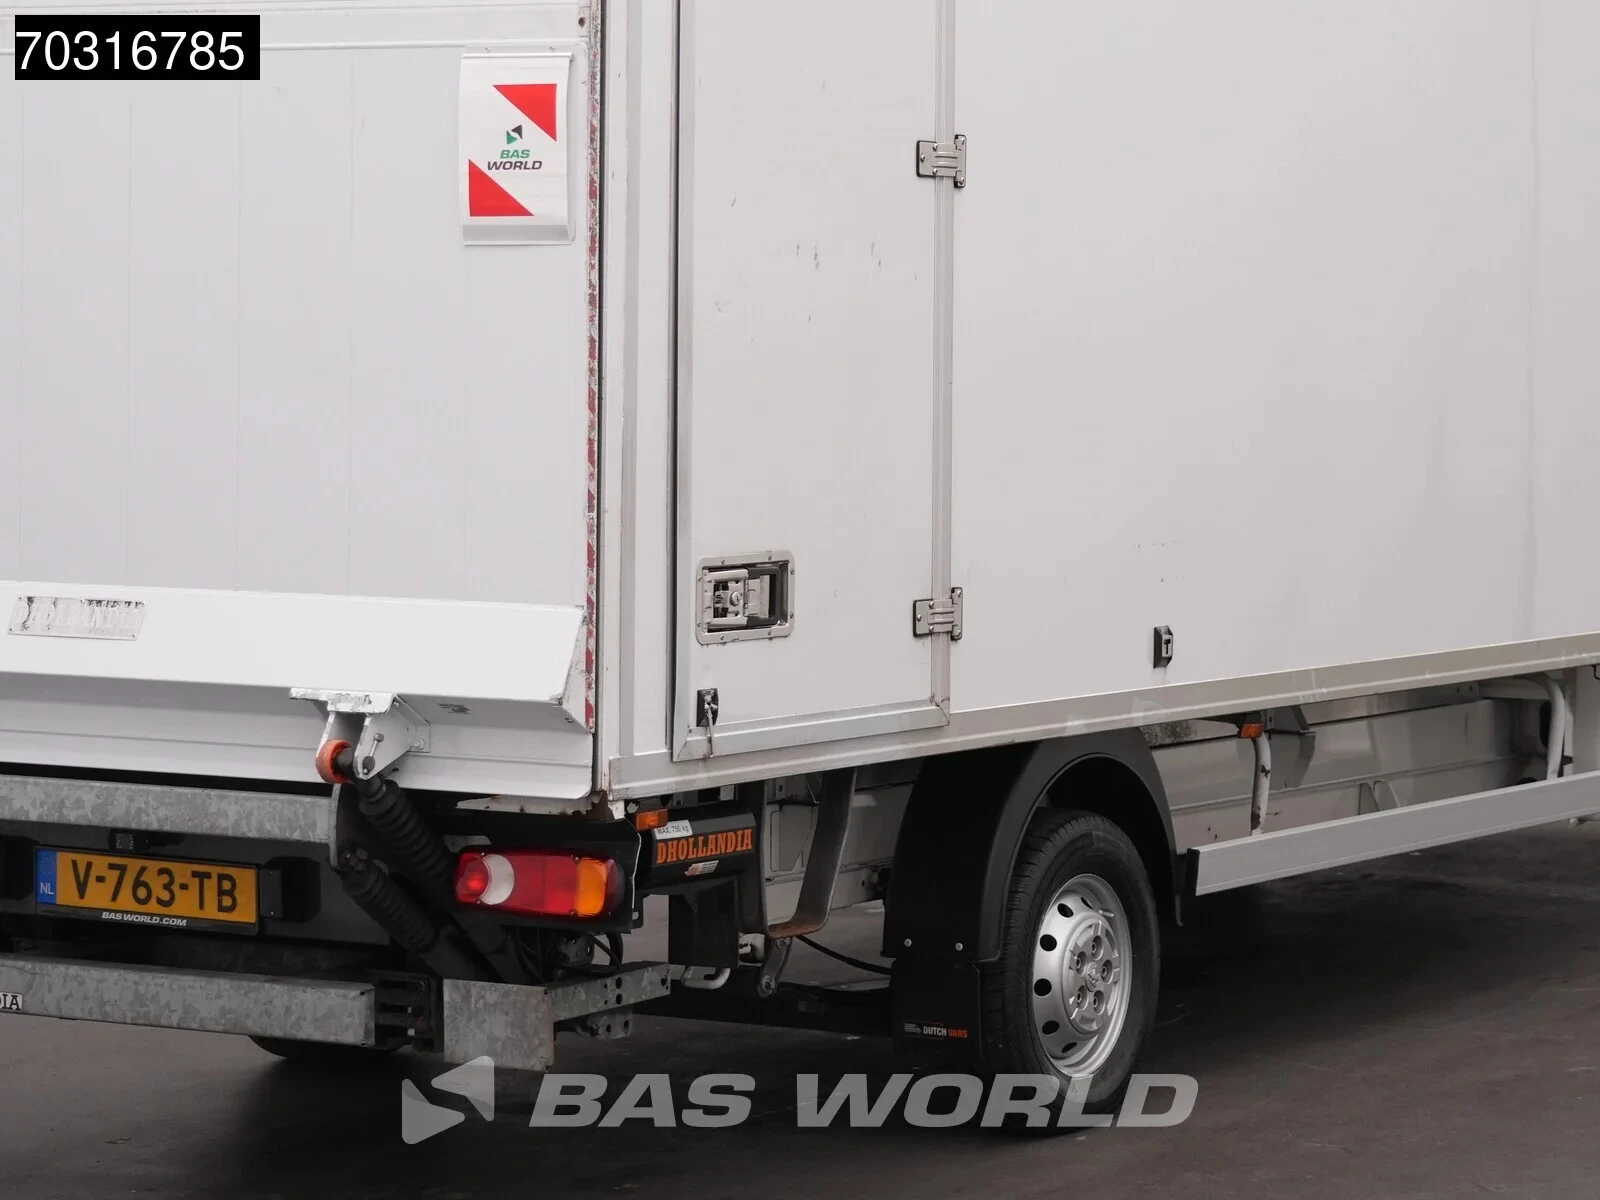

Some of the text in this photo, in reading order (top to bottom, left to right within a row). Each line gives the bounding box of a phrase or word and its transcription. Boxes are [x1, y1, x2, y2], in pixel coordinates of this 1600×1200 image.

[500, 149, 531, 159] BAS
[487, 160, 543, 171] WORLD
[671, 825, 682, 833] 750
[656, 828, 753, 864] DHOLLANDIA
[40, 882, 54, 895] NL
[71, 859, 238, 913] V-763-TB
[0, 993, 21, 1010] IA
[923, 1026, 947, 1036] DUTCH
